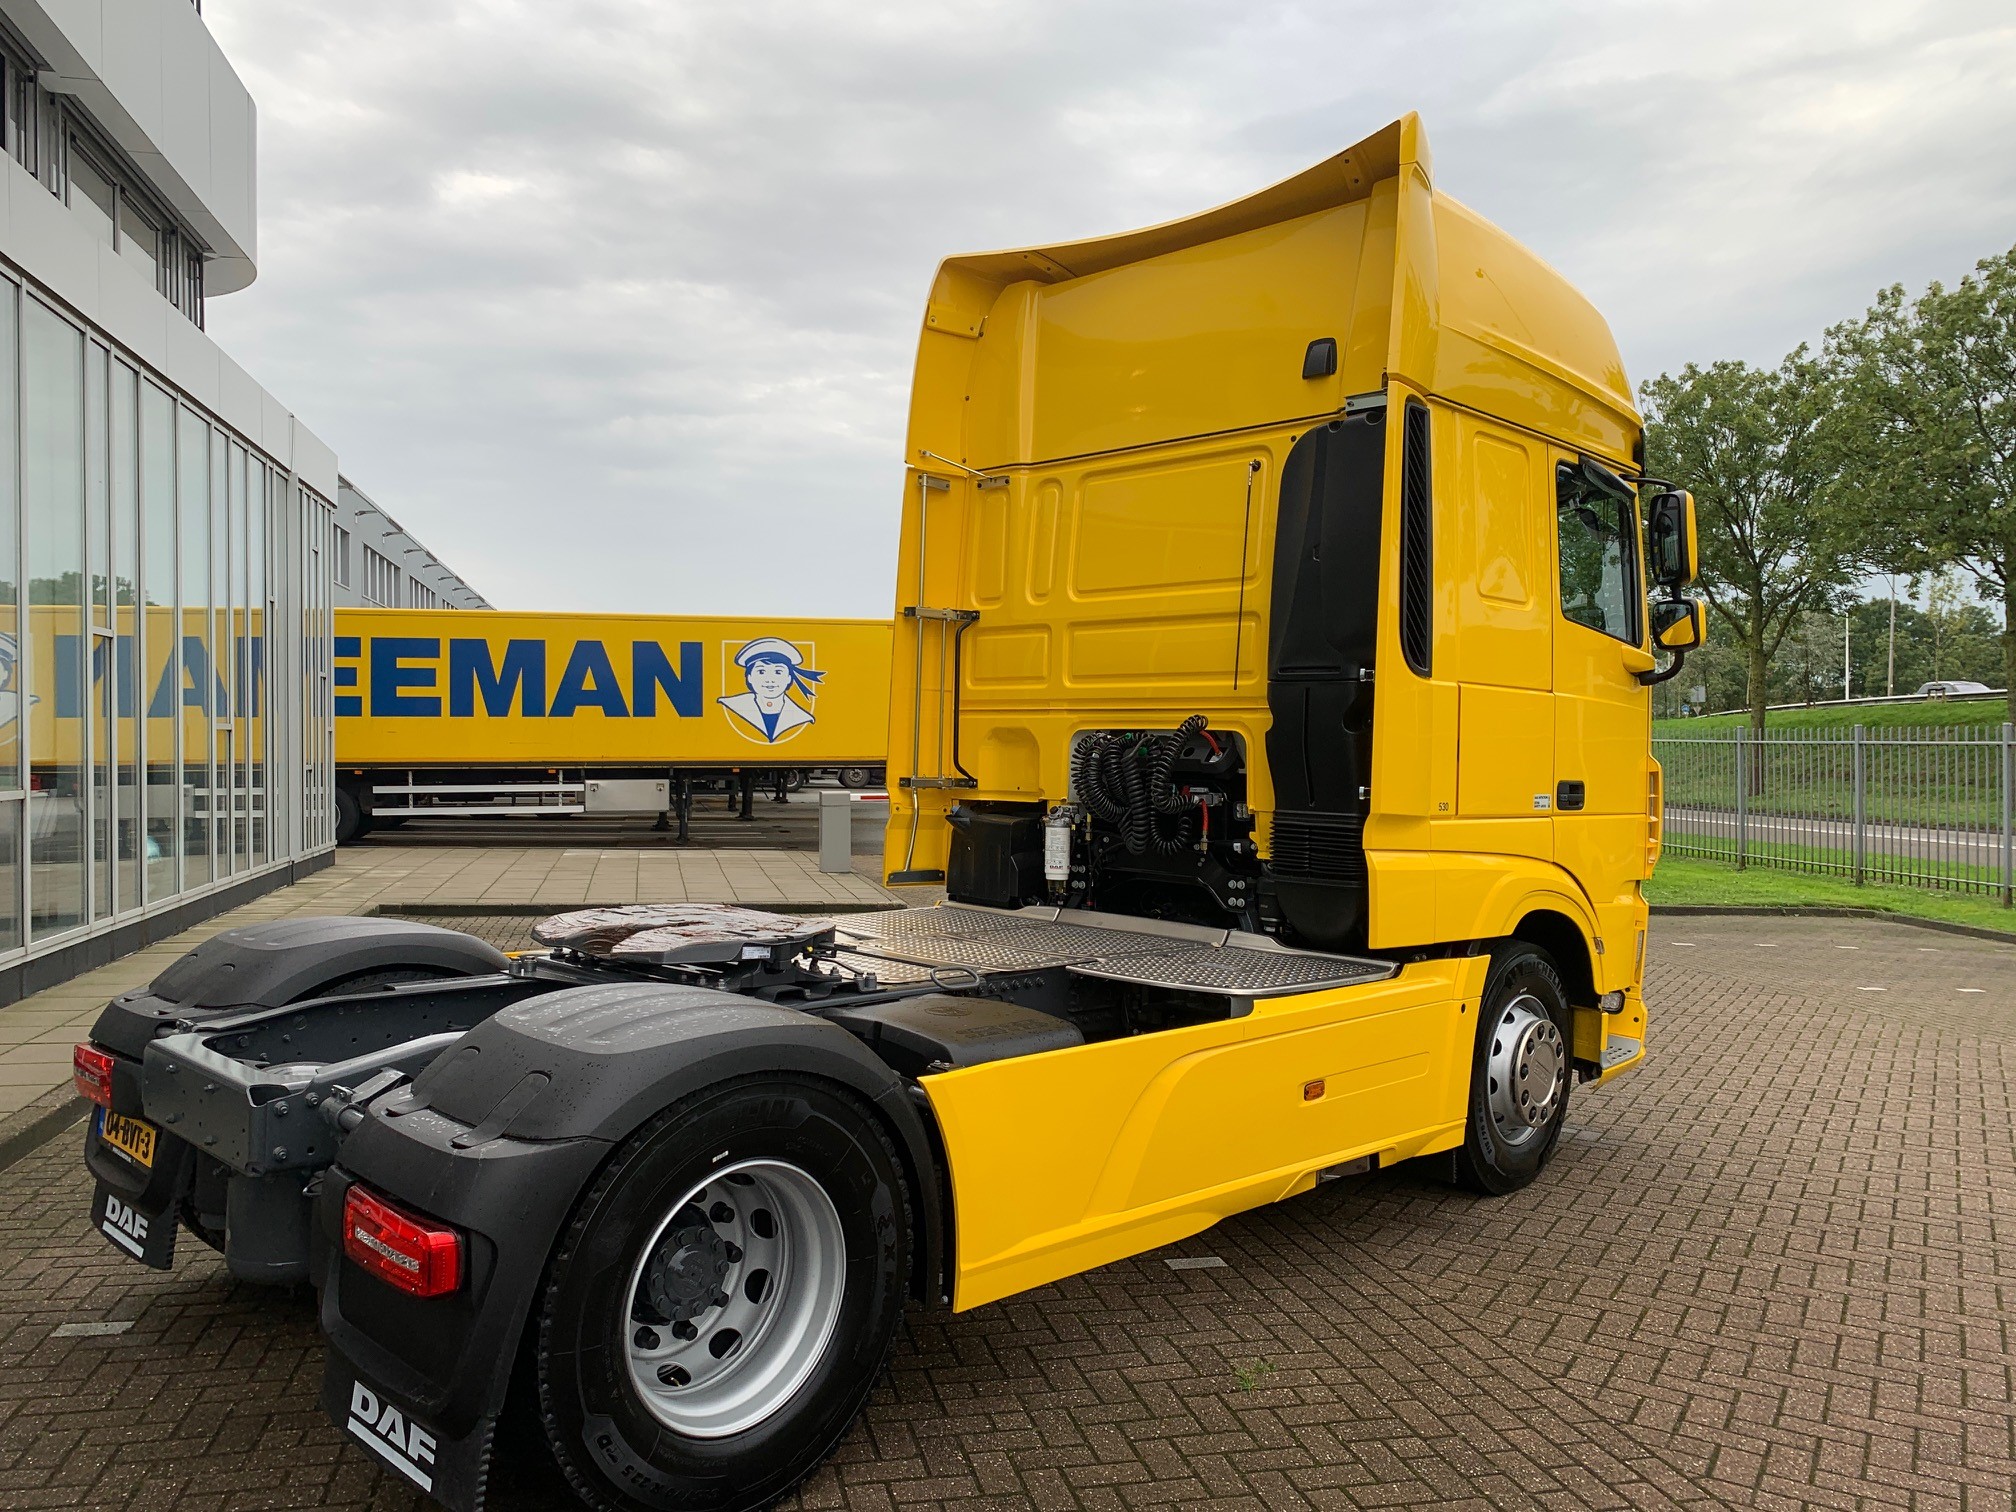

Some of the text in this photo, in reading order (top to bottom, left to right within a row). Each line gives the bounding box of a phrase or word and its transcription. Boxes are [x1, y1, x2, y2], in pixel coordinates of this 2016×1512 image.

[1438, 802, 1449, 811] 530
[106, 1109, 151, 1159] 04-BVT-3
[105, 1194, 149, 1239] DAF
[351, 1380, 437, 1466] DAF
